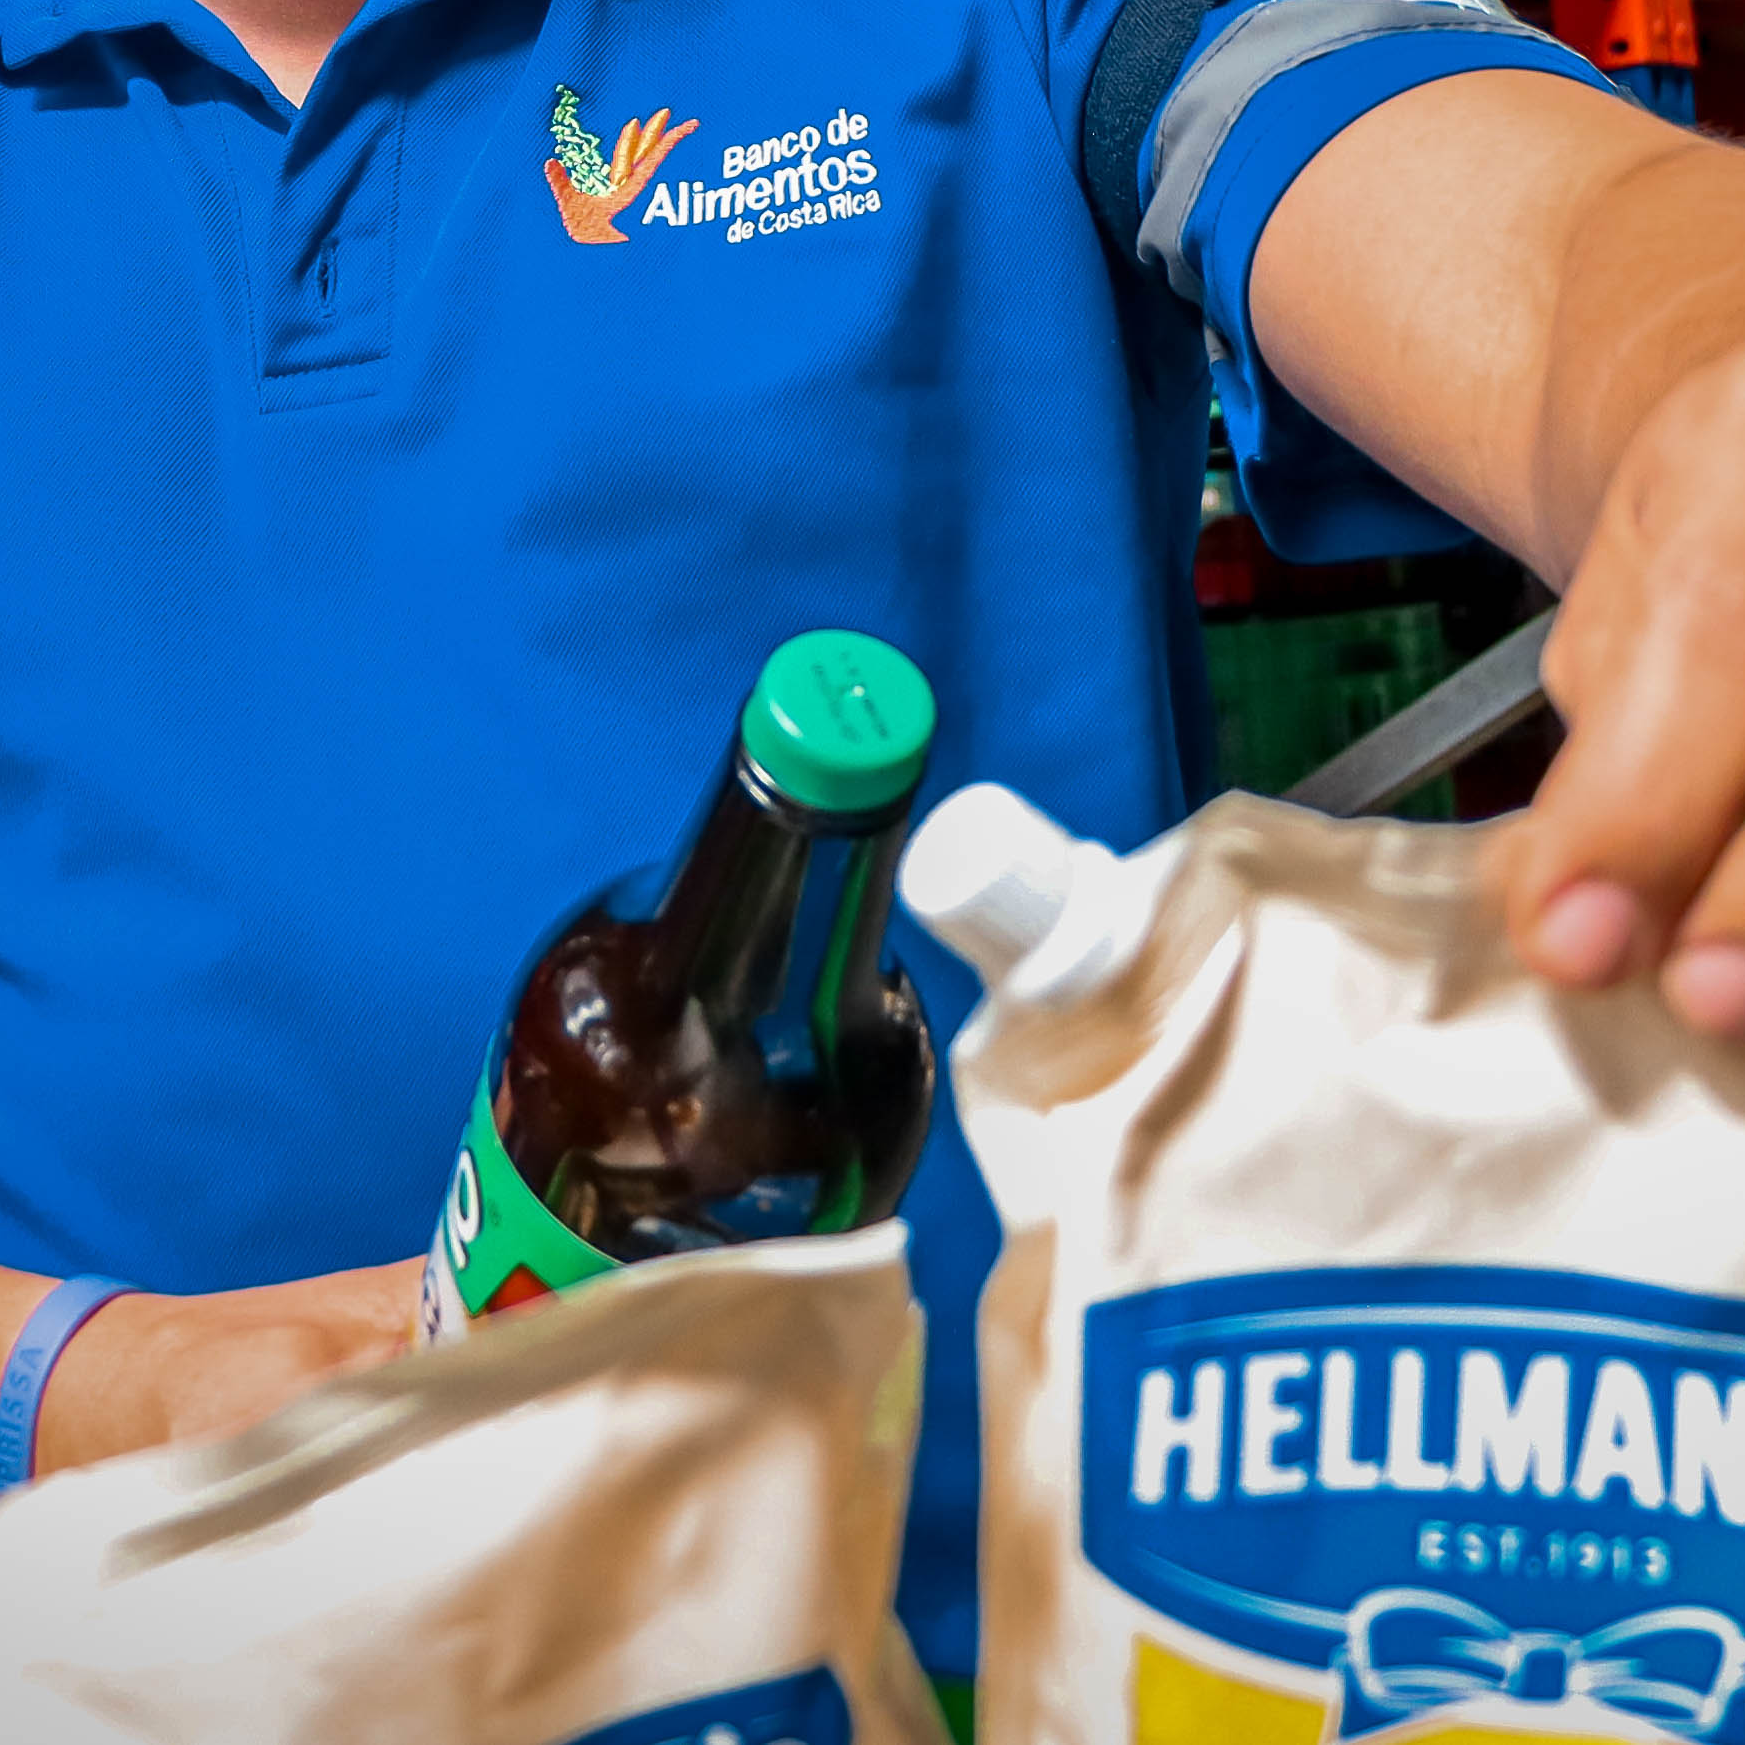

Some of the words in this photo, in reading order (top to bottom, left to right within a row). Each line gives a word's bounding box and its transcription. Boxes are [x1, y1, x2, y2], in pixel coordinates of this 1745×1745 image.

[722, 124, 822, 180] Banco
[826, 107, 870, 148] de
[641, 148, 878, 227] Alimentos
[726, 216, 755, 244] de
[757, 201, 828, 235] Costa
[830, 189, 882, 220] Rica
